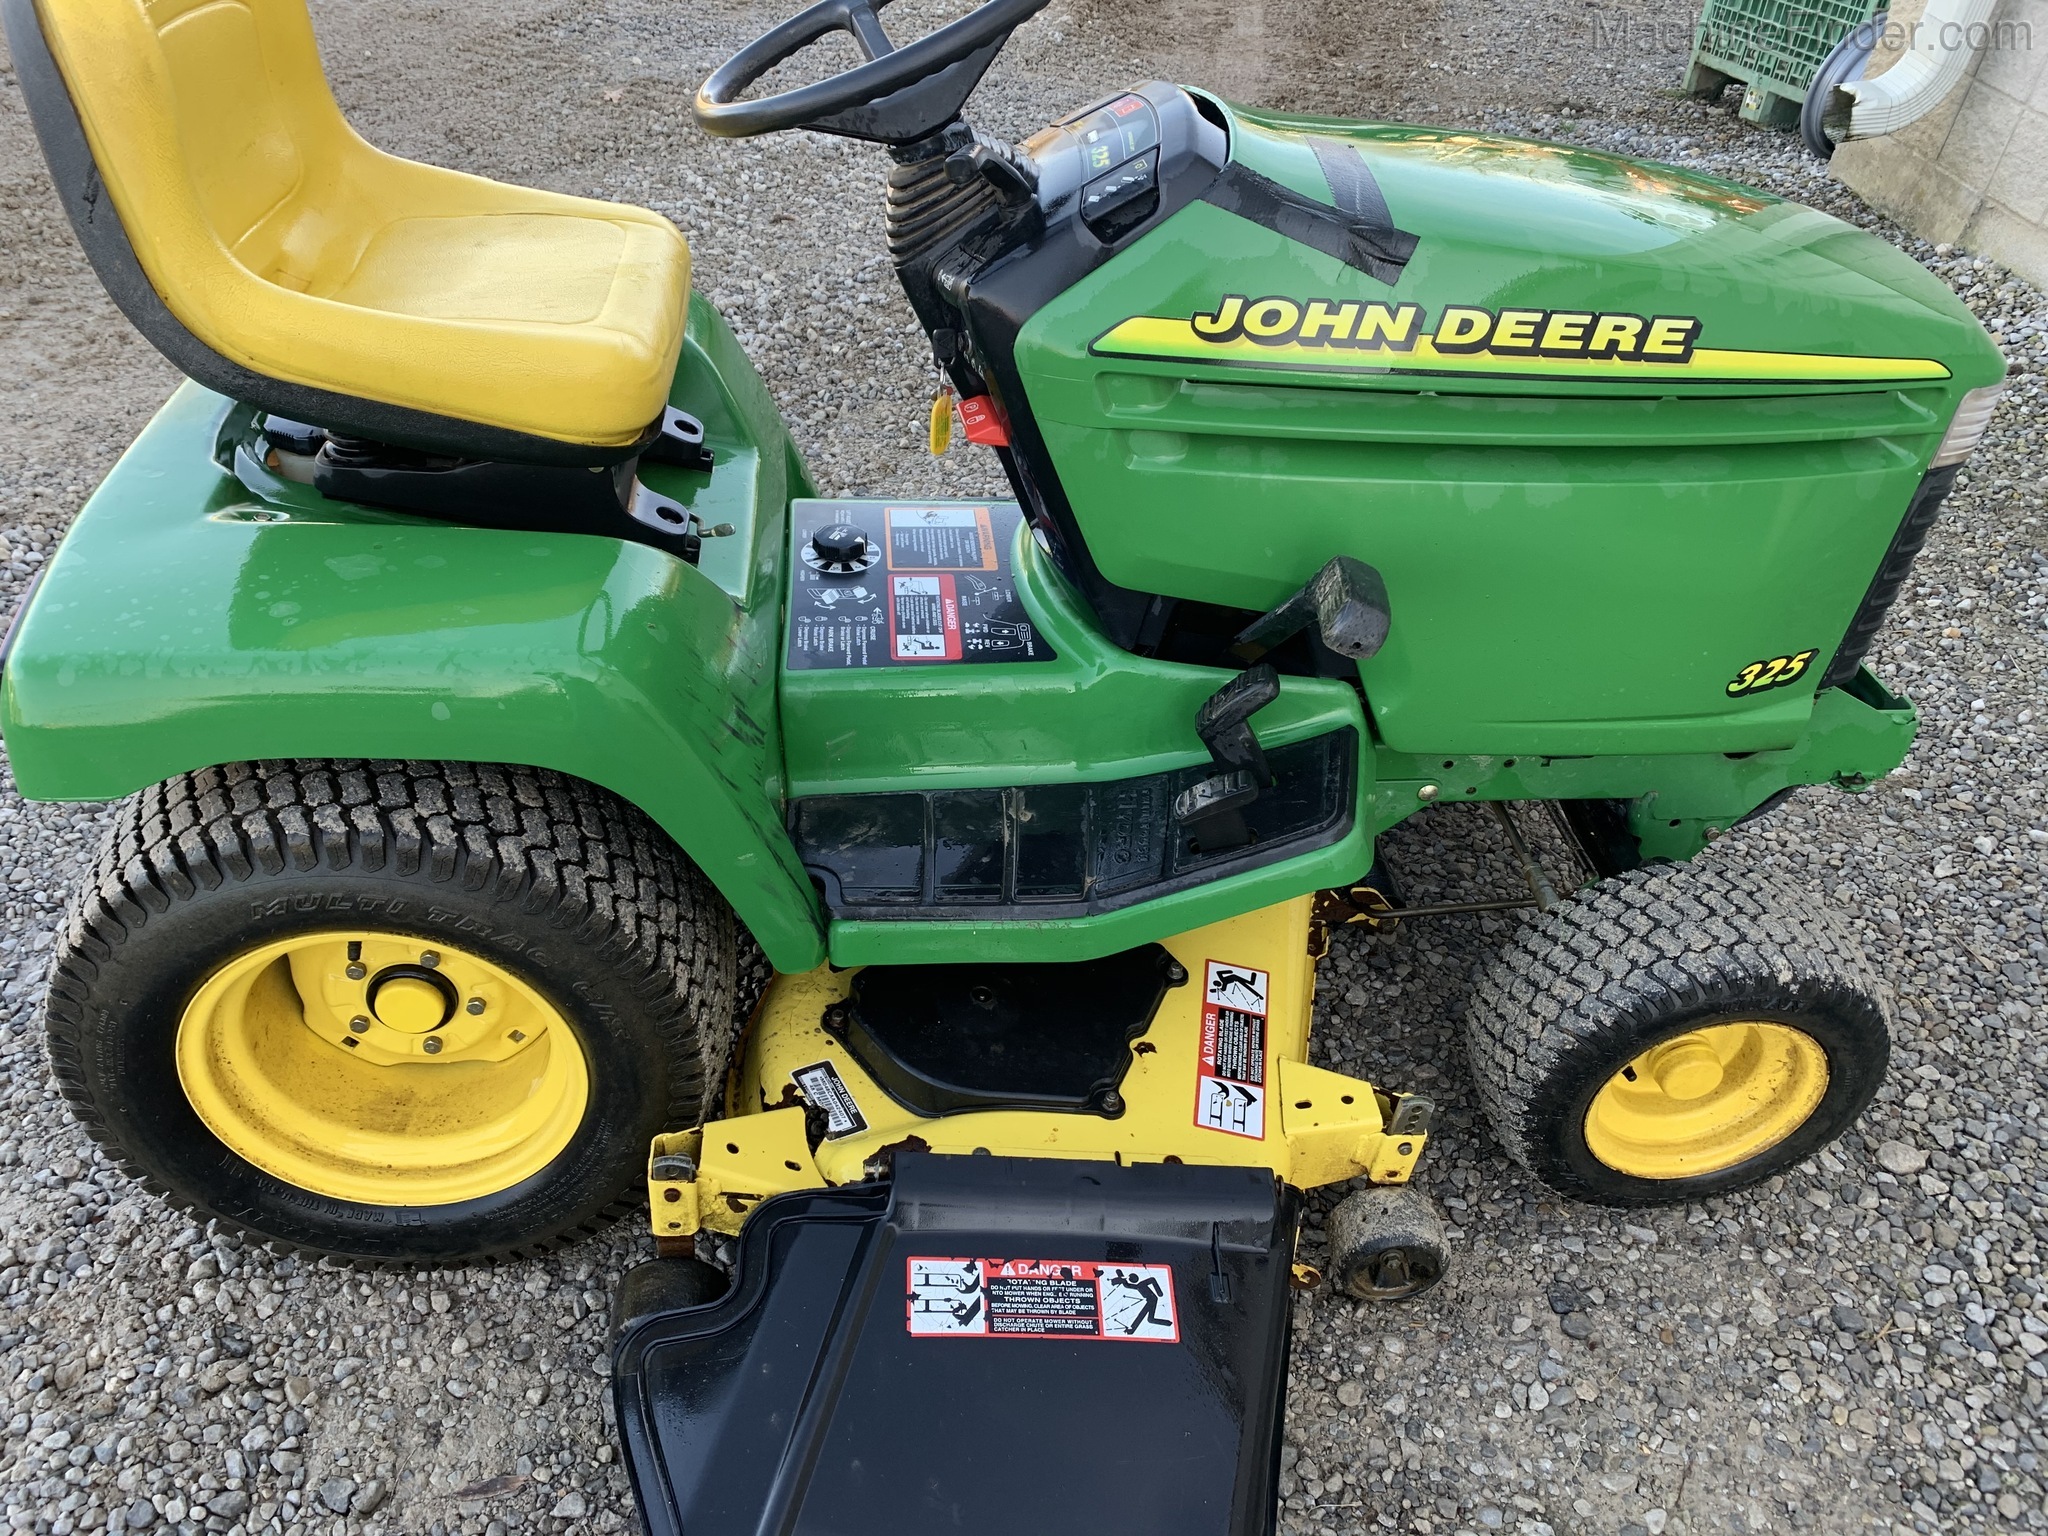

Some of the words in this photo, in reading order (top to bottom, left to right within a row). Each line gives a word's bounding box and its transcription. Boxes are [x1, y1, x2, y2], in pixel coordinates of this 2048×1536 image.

[1091, 145, 1110, 168] 325
[1193, 295, 1424, 352] JOHN
[1433, 305, 1701, 362] DEERE
[946, 605, 956, 630] DANGER
[1727, 649, 1817, 697] 325
[251, 893, 408, 920] MULTI
[428, 905, 549, 967] TRAC
[1203, 1013, 1216, 1054] DANGER
[831, 1076, 845, 1094] JOHN
[841, 1093, 858, 1114] DEERE
[347, 1208, 384, 1222] MADE
[1017, 1263, 1082, 1277] DANGR
